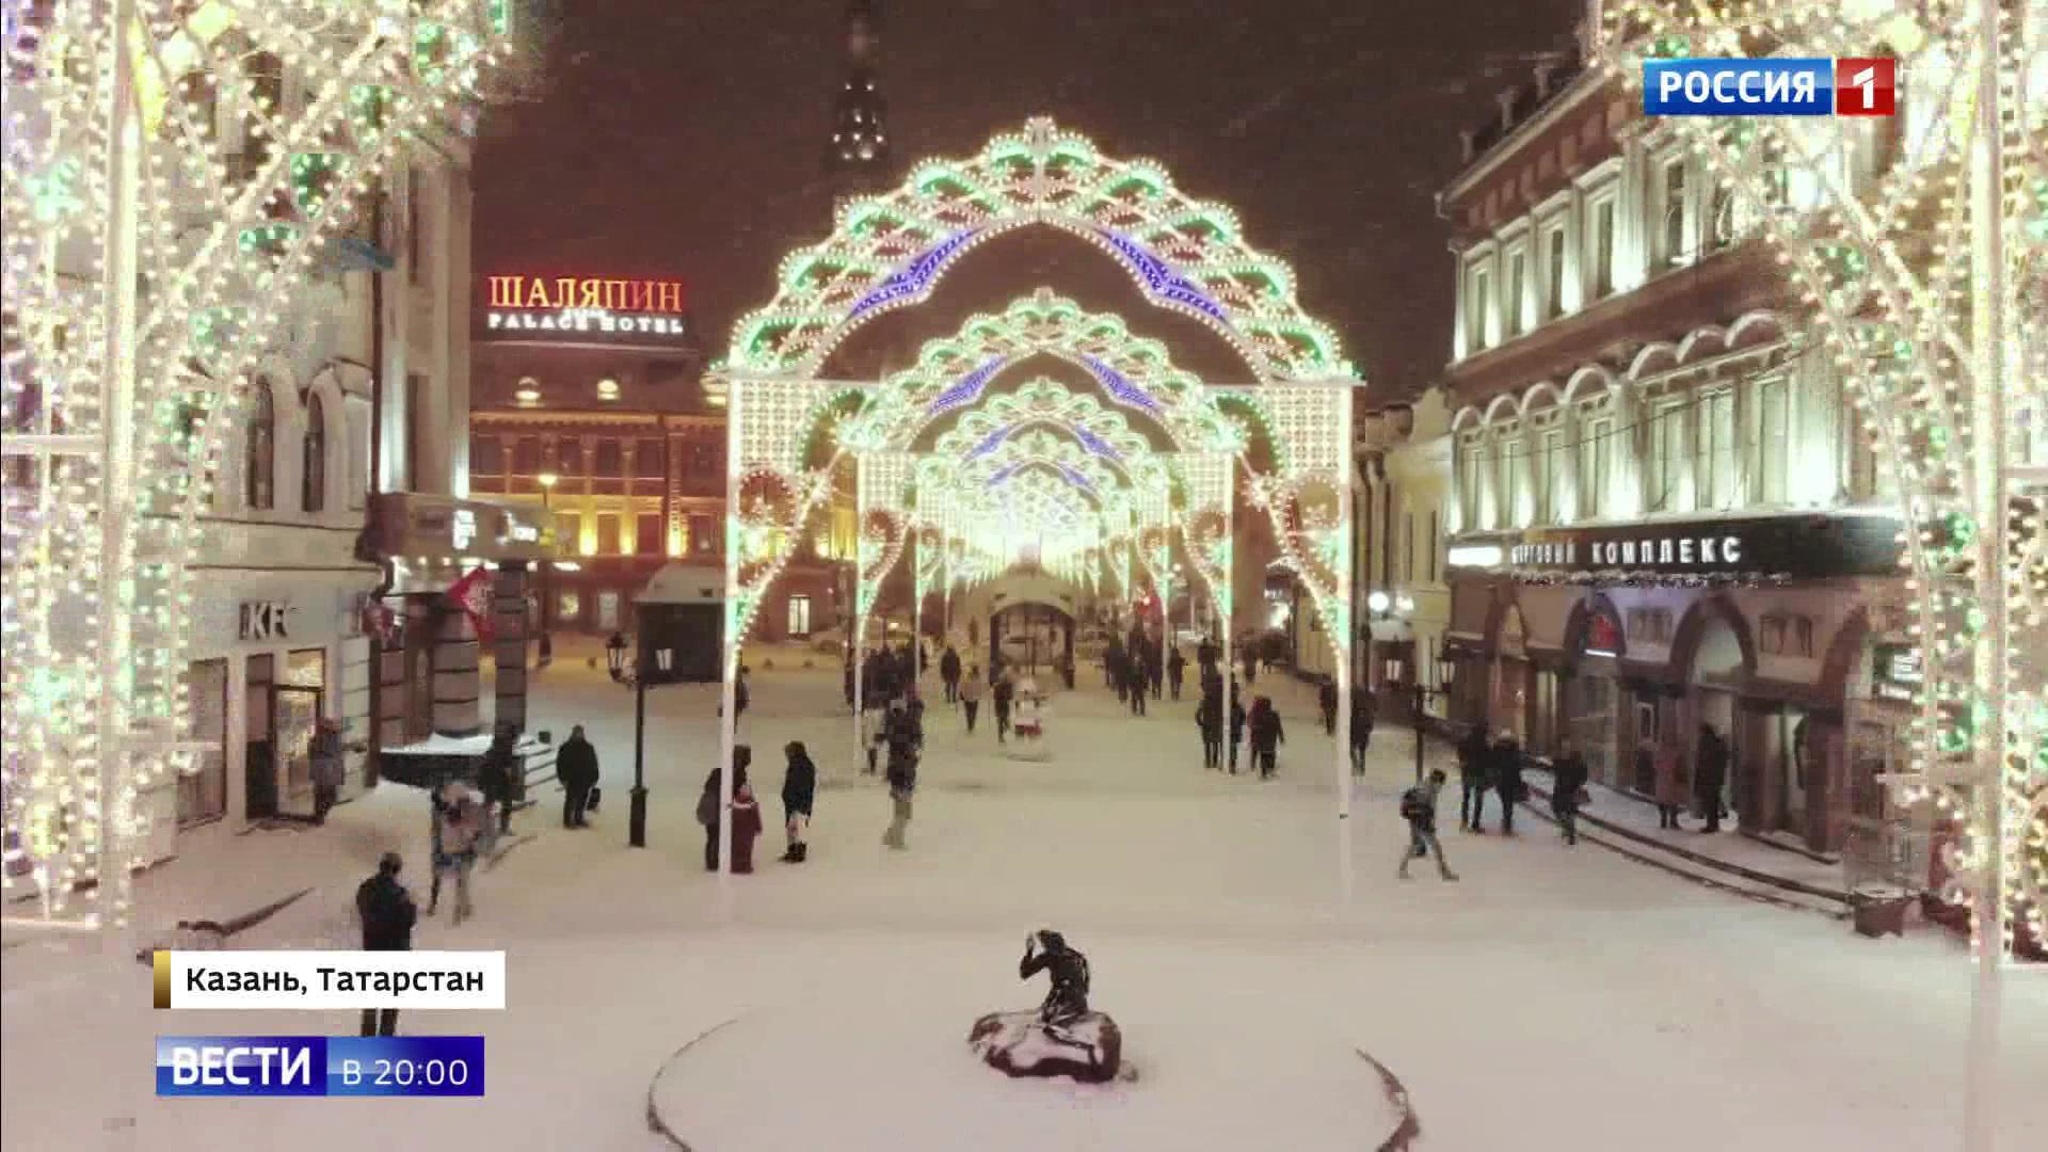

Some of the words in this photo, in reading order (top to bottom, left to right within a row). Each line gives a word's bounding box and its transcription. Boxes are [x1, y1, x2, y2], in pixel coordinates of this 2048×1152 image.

[488, 275, 683, 313] ШАЛЯПИН
[488, 313, 588, 332] PALACE
[600, 315, 684, 334] HOTEL
[1592, 536, 1742, 564] КОМПЛЕКС
